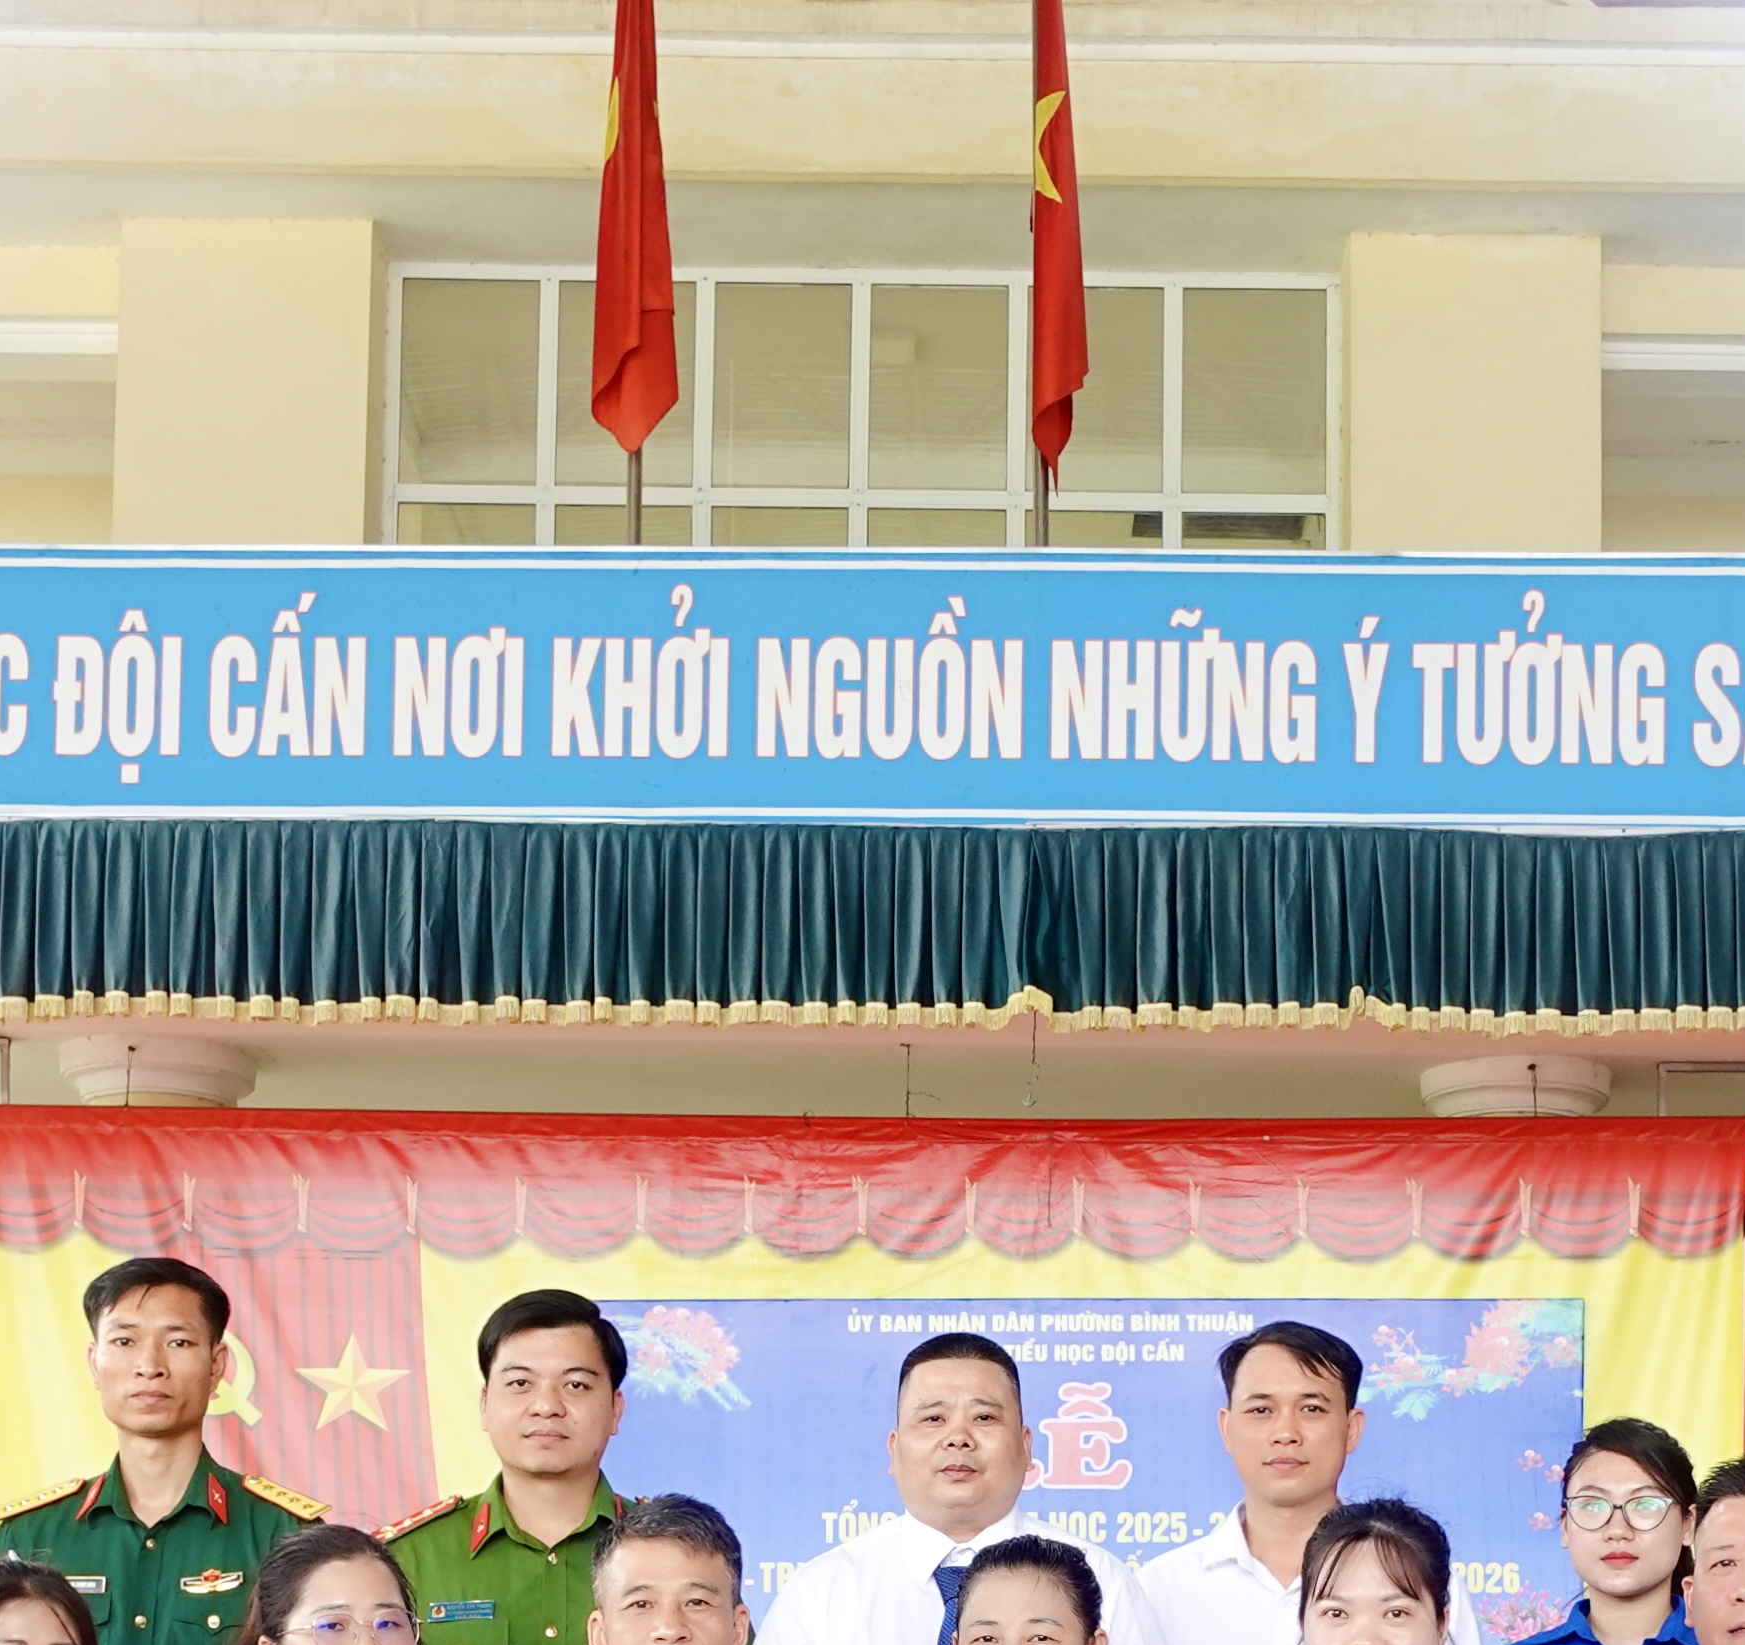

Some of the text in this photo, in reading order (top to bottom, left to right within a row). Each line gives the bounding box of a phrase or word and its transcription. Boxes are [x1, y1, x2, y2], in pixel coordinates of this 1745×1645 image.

[53, 608, 183, 784] ĐỘI
[208, 591, 367, 758] CẤN
[392, 625, 525, 759] NƠI
[550, 583, 730, 760] KHỞI
[756, 595, 1024, 761] NGUỒN
[1050, 607, 1317, 764] NHỮNG
[1342, 615, 1391, 764] Ý
[1412, 588, 1666, 767] TƯỞNG
[847, 1307, 1253, 1336] ỦY BAN NHÂN DÂN PHƯỜNG BÌNH THUẬN
[1004, 1338, 1184, 1366] TIỂU HỌC ĐỘI CẤN
[1116, 1510, 1188, 1544] 2025
